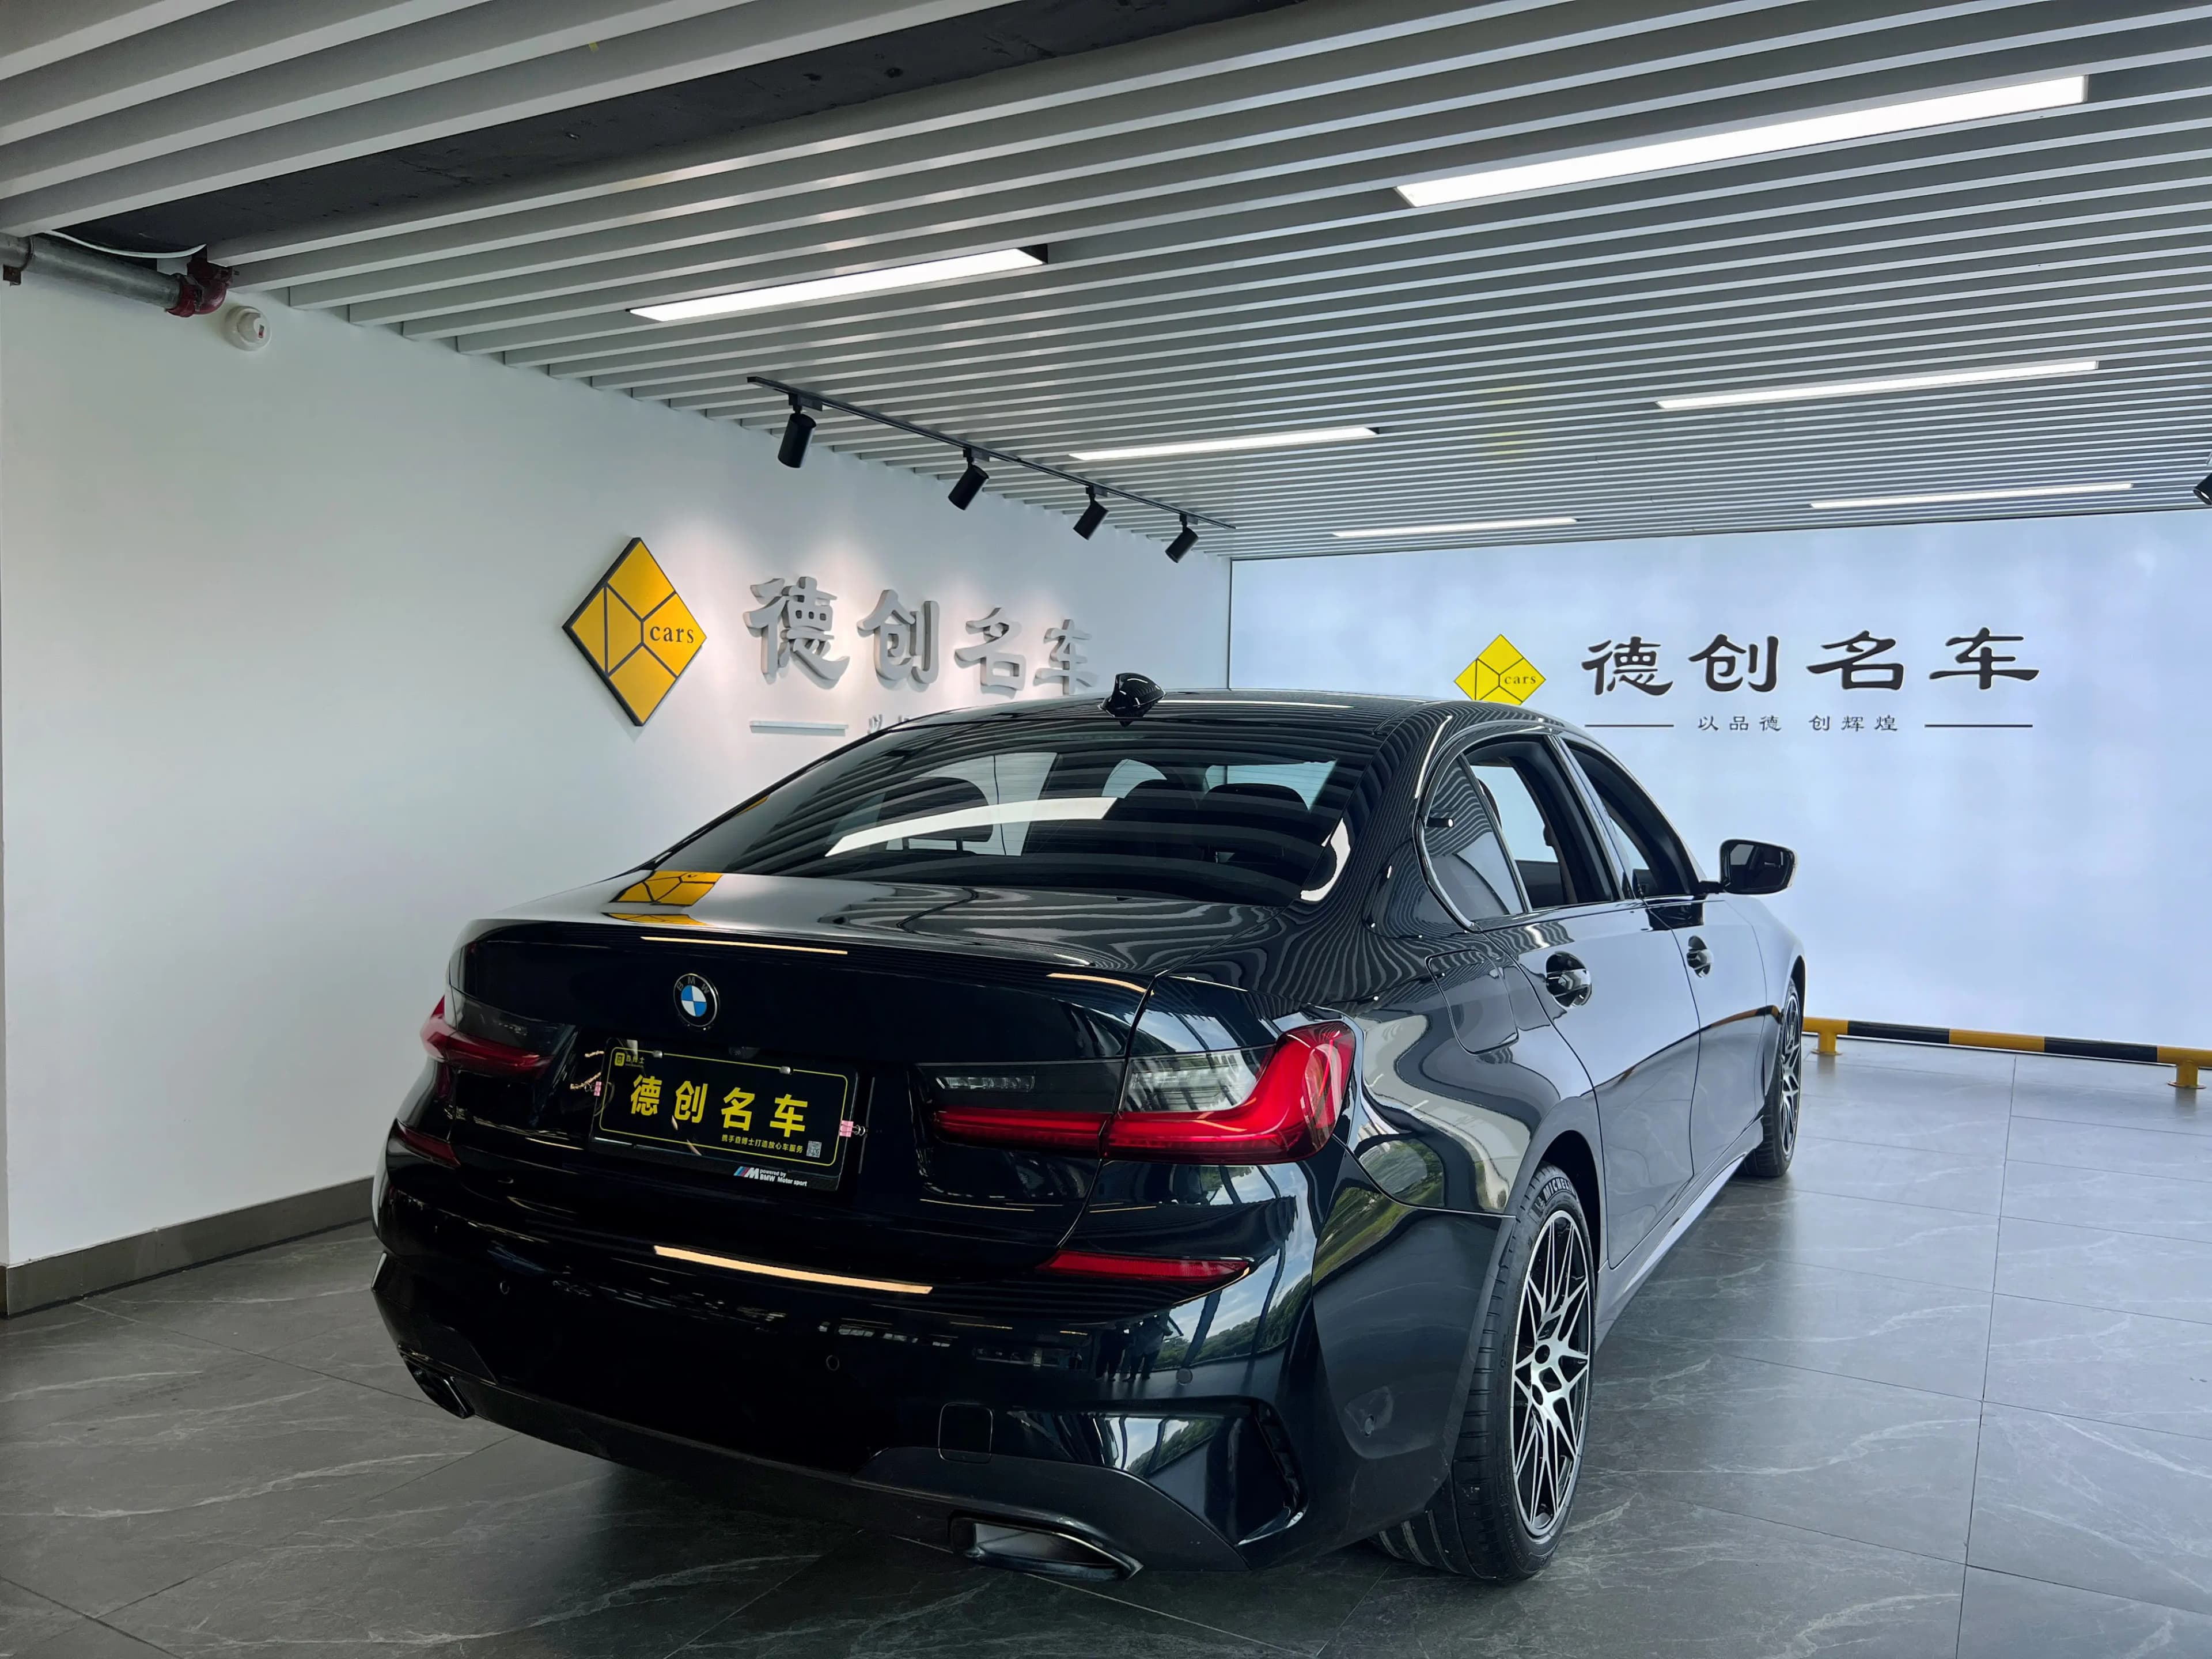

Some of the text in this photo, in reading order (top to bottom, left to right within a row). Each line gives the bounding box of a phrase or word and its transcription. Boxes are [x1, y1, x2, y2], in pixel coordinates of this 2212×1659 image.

[650, 626, 695, 644] cars
[743, 576, 1096, 696] 德创名车
[1581, 627, 2040, 695] 德创名车
[1504, 676, 1537, 685] cars
[1698, 714, 1898, 733] 以品德 创辉煌
[676, 976, 710, 994] BMW
[630, 1074, 809, 1138] 德创名车
[759, 1168, 780, 1177] powered
[759, 1173, 775, 1183] BMW
